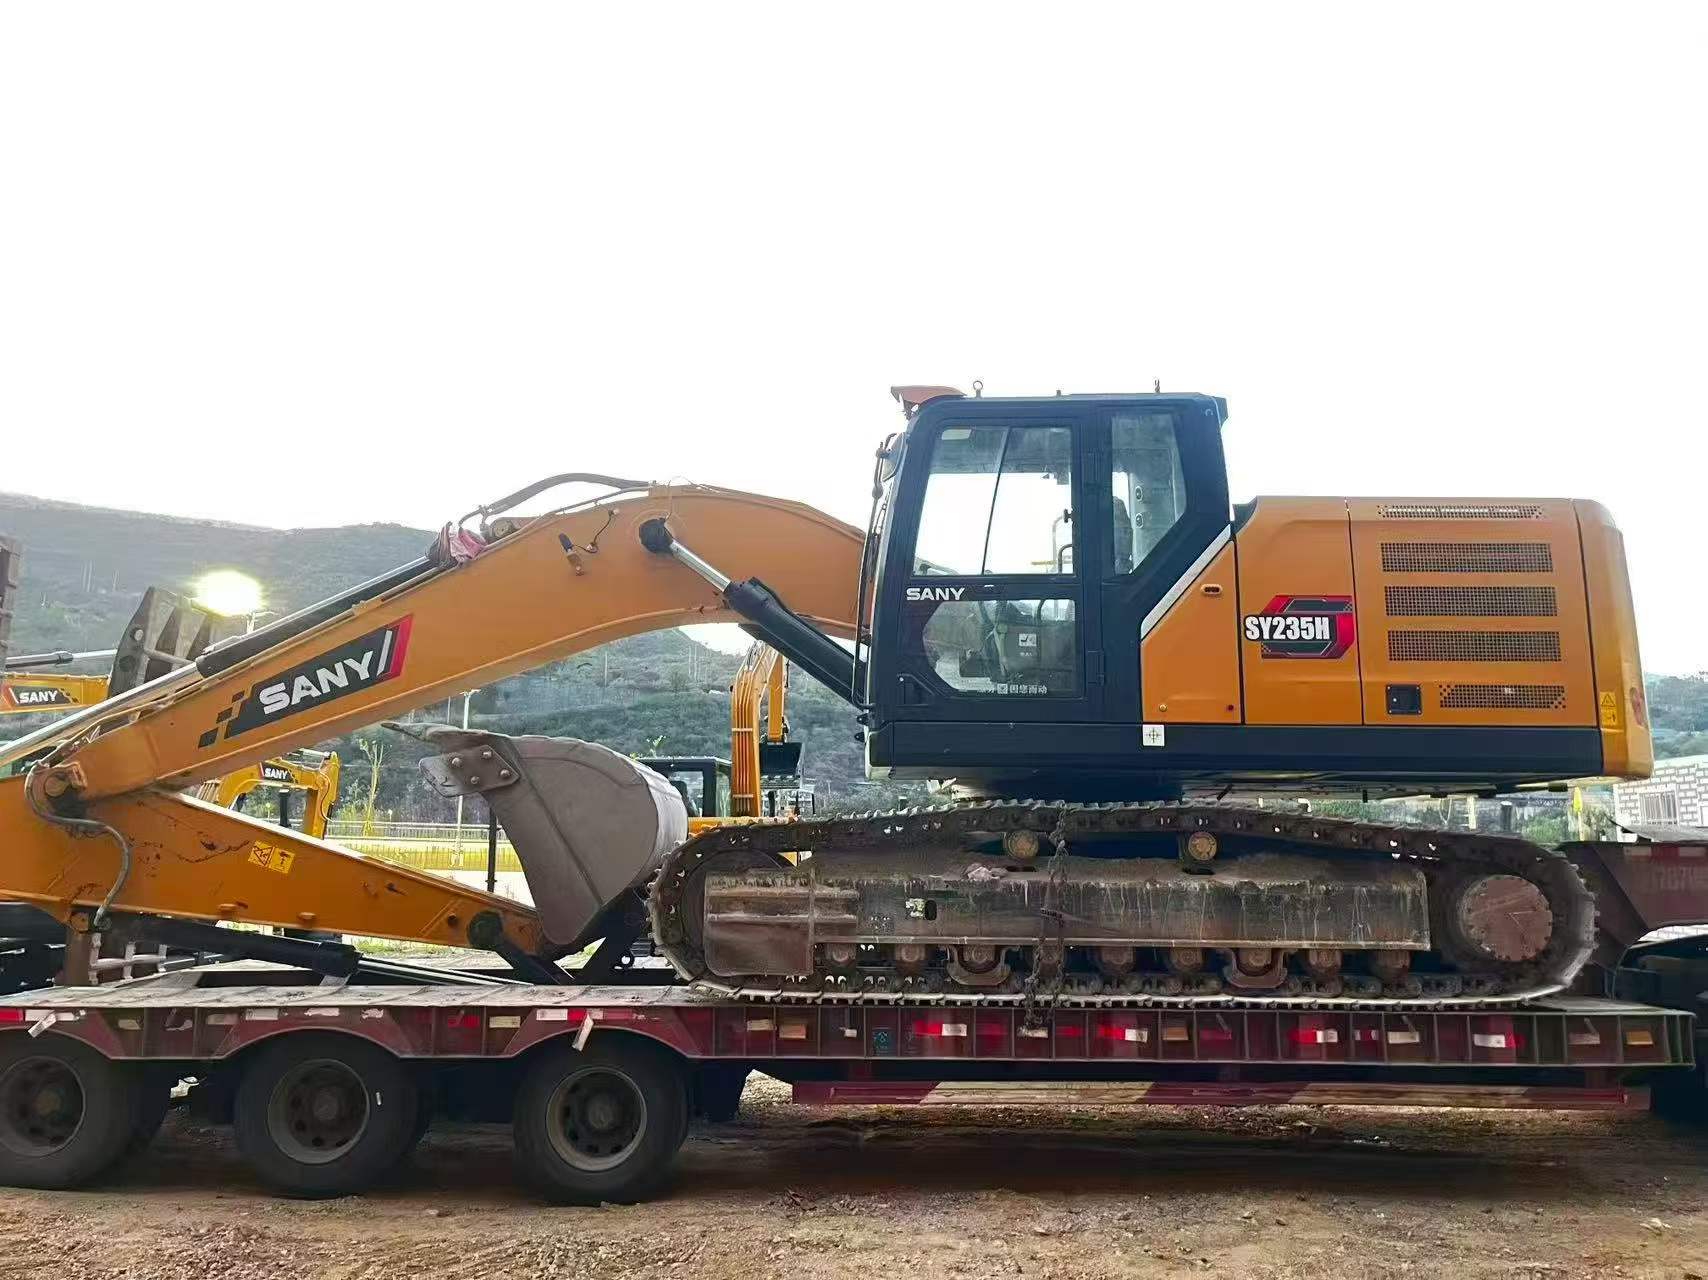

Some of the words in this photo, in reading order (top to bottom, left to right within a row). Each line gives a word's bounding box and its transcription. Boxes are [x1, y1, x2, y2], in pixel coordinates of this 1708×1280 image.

[906, 587, 965, 600] SANY
[1245, 616, 1330, 640] SY235H
[259, 650, 373, 714] SANY
[19, 690, 58, 703] SANY
[264, 767, 288, 779] SANY
